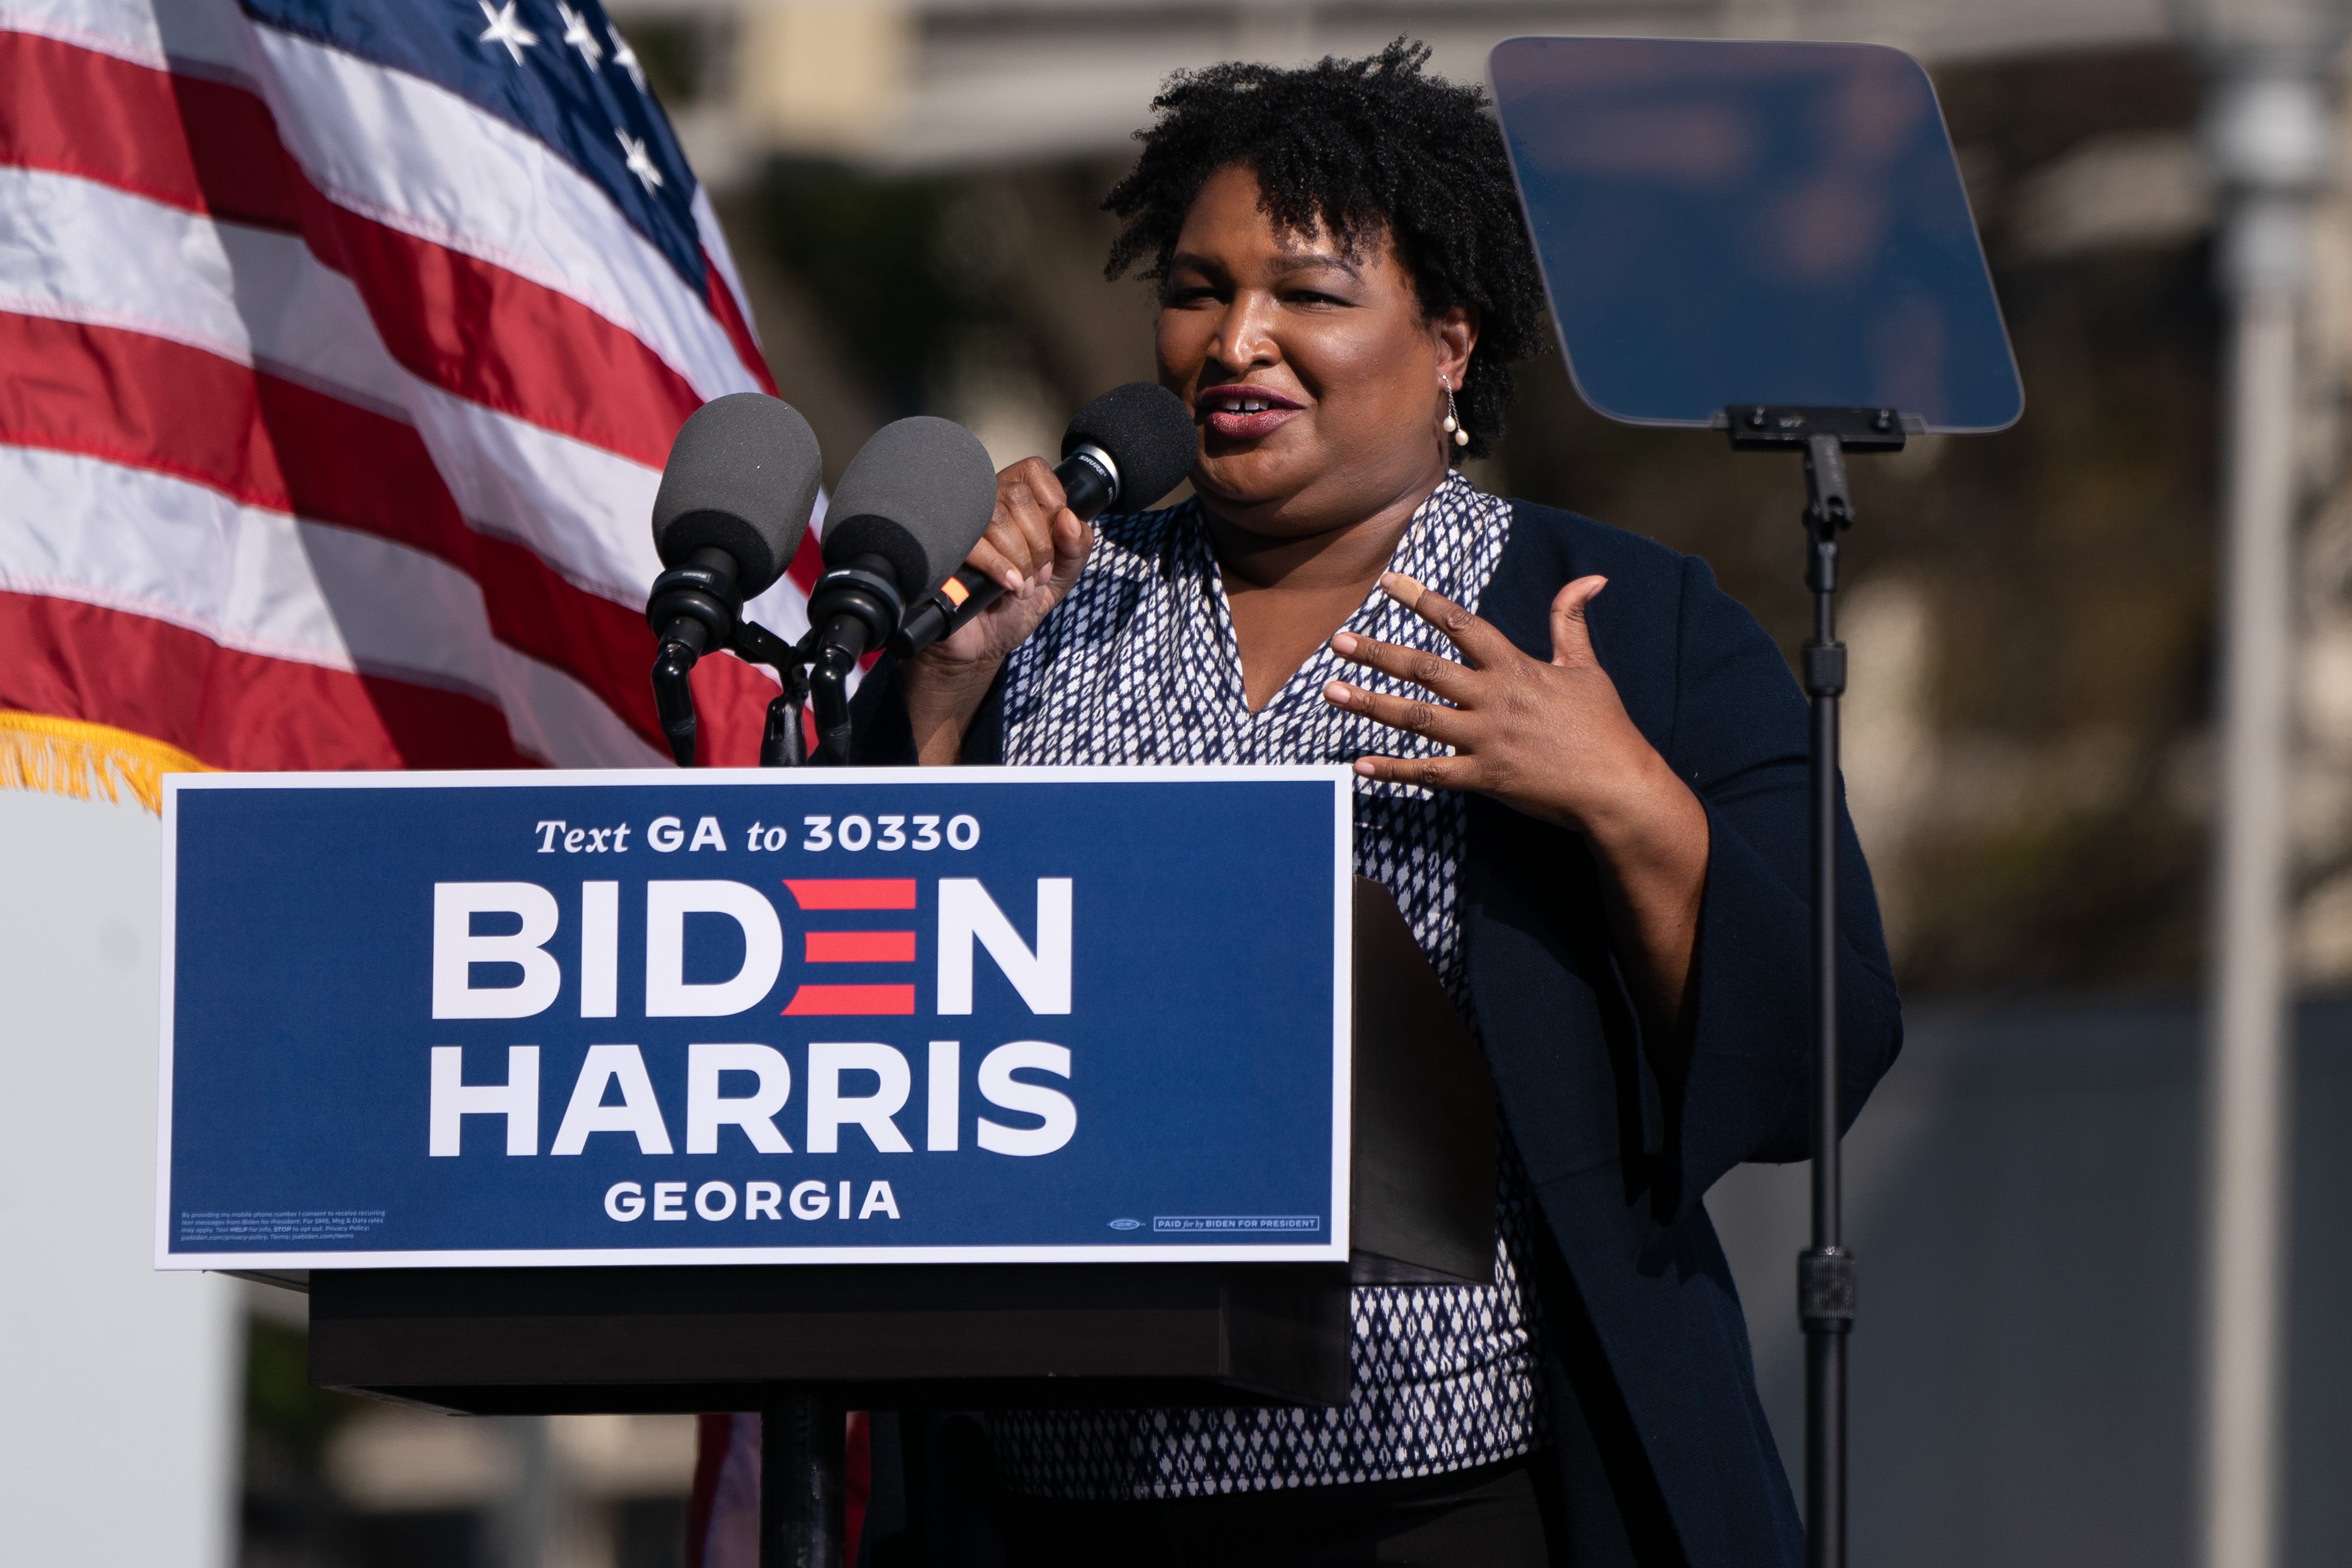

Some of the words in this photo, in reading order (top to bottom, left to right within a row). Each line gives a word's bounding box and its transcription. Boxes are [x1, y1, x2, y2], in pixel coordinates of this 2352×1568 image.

[535, 820, 631, 853] Text
[647, 816, 727, 852] GA
[747, 821, 787, 852] to
[803, 814, 980, 852] 30330
[432, 878, 1073, 1019] BIDEN
[429, 1041, 1077, 1157] HARRIS
[604, 1181, 901, 1221] GEORGIA
[1182, 1220, 1194, 1230] for
[1195, 1220, 1205, 1229] by
